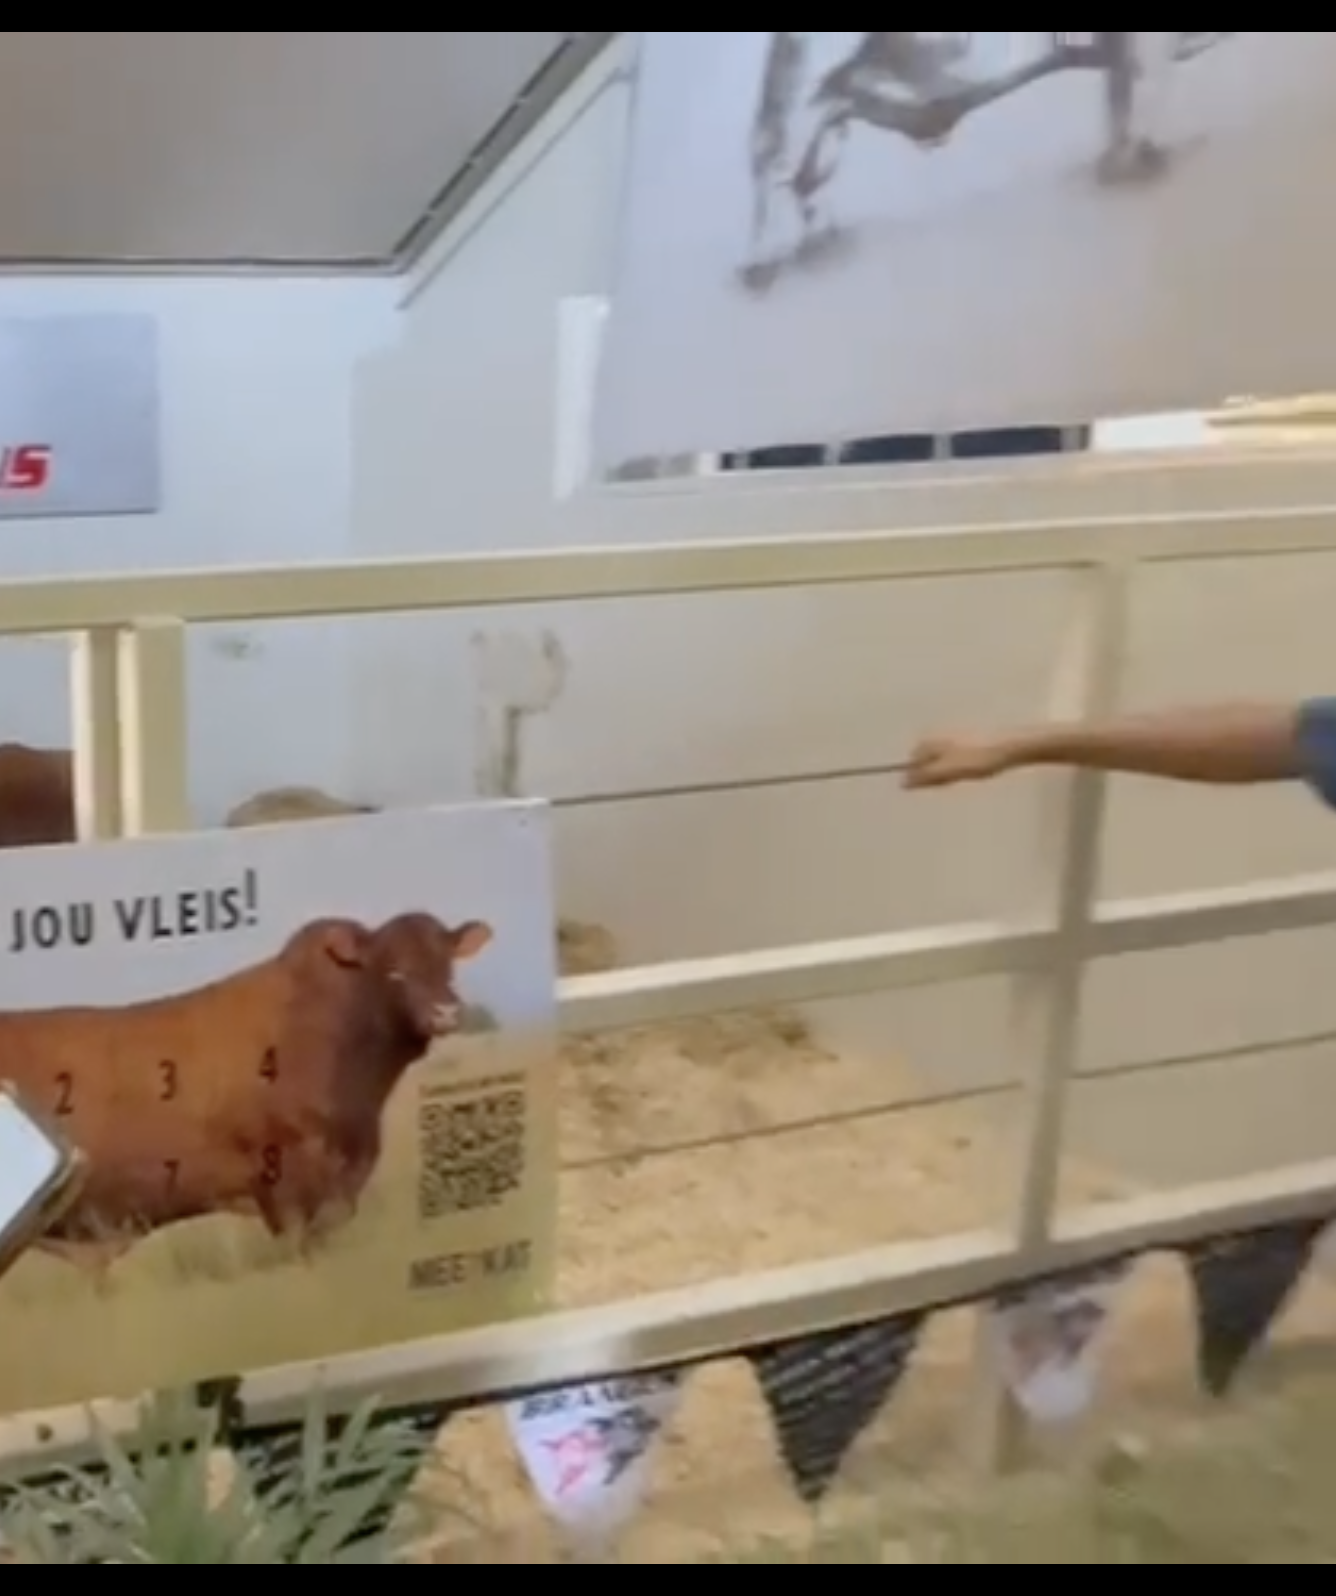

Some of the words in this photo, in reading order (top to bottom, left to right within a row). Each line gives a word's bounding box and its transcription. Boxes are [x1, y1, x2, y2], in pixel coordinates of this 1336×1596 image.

[9, 900, 94, 953] JOU
[113, 867, 258, 942] VLEIS!
[158, 1058, 178, 1102] 3
[258, 1046, 280, 1085] 4
[54, 1070, 74, 1117] 2
[163, 1158, 181, 1200] 7
[408, 1239, 532, 1290] MEEKAT
